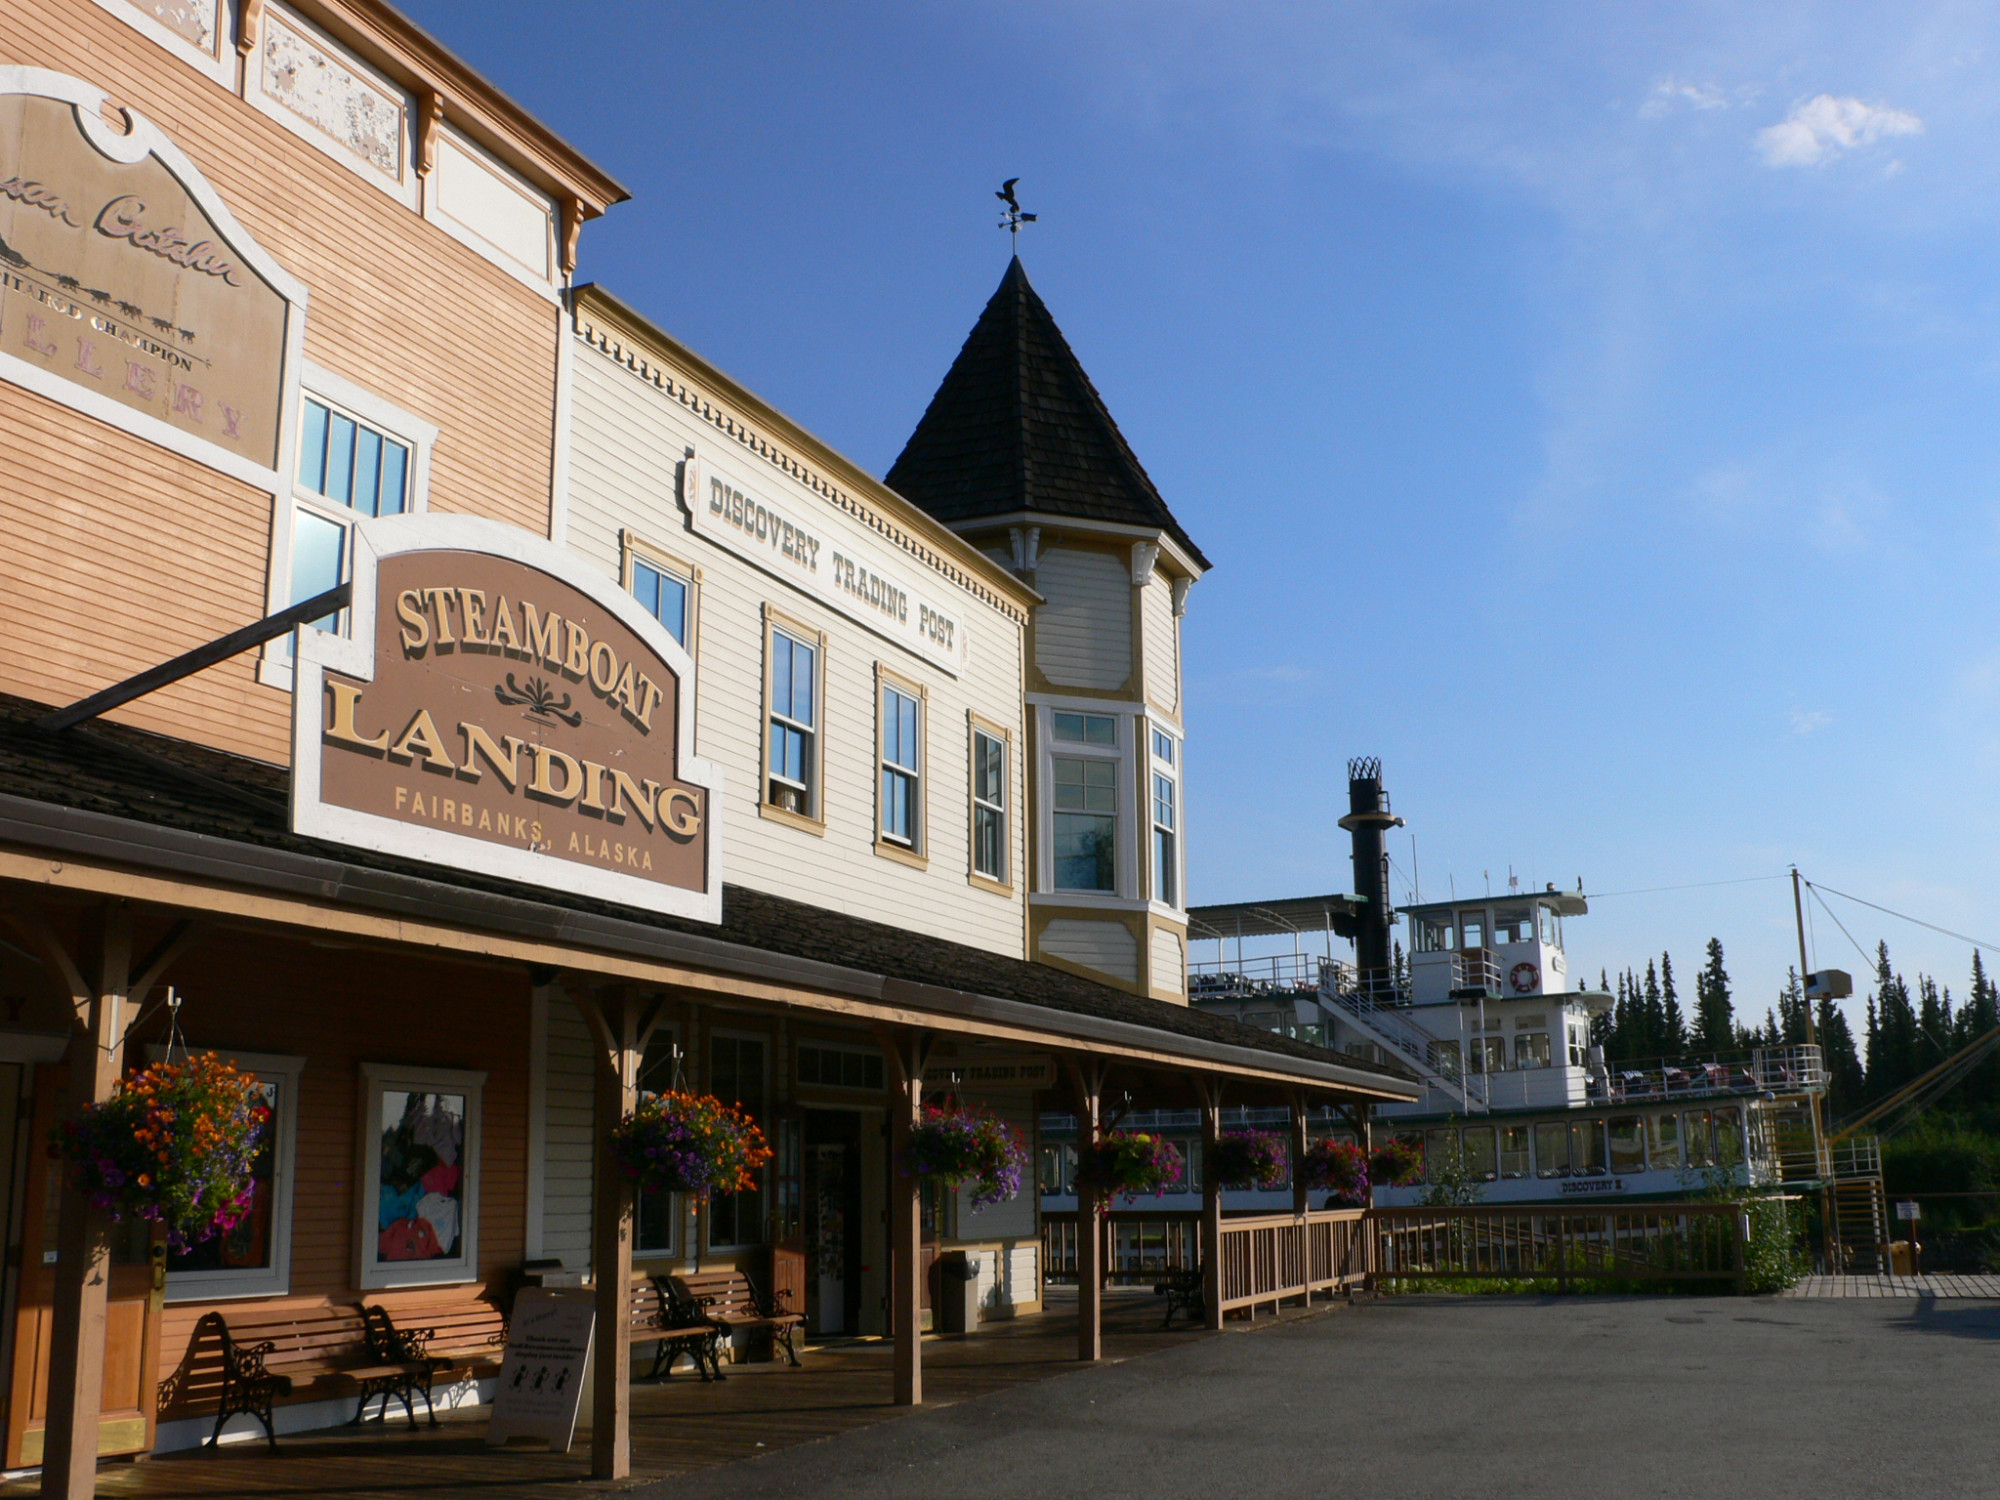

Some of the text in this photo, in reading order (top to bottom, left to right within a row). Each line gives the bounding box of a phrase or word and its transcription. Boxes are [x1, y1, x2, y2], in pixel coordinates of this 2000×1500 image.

[0, 269, 193, 372] ITAROD CHAMPION
[0, 313, 249, 442] LLERY
[709, 475, 955, 651] DISCOVERY TRADING POST
[325, 586, 701, 837] STEAMBOAT LANDING
[568, 831, 653, 871] ALASKA
[1562, 1180, 1613, 1193] DISCOVERY
